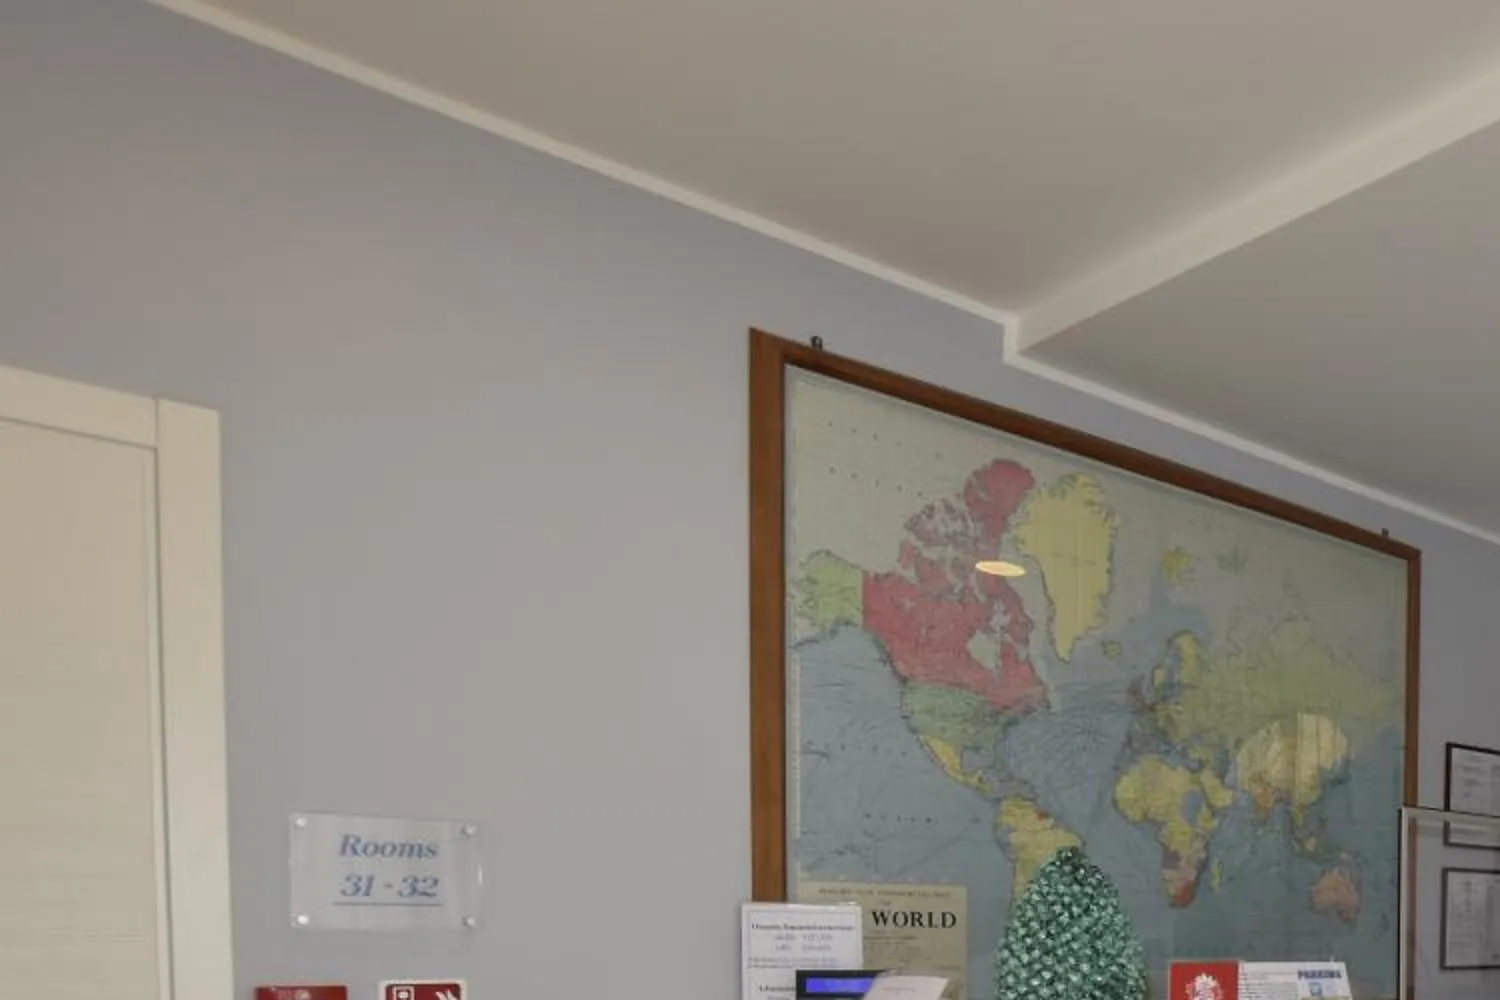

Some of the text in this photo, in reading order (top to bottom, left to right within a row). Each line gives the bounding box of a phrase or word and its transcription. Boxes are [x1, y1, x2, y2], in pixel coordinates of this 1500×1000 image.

[340, 835, 438, 859] Rooms
[341, 874, 374, 897] 31
[397, 876, 439, 898] 32
[872, 911, 957, 929] WORLD
